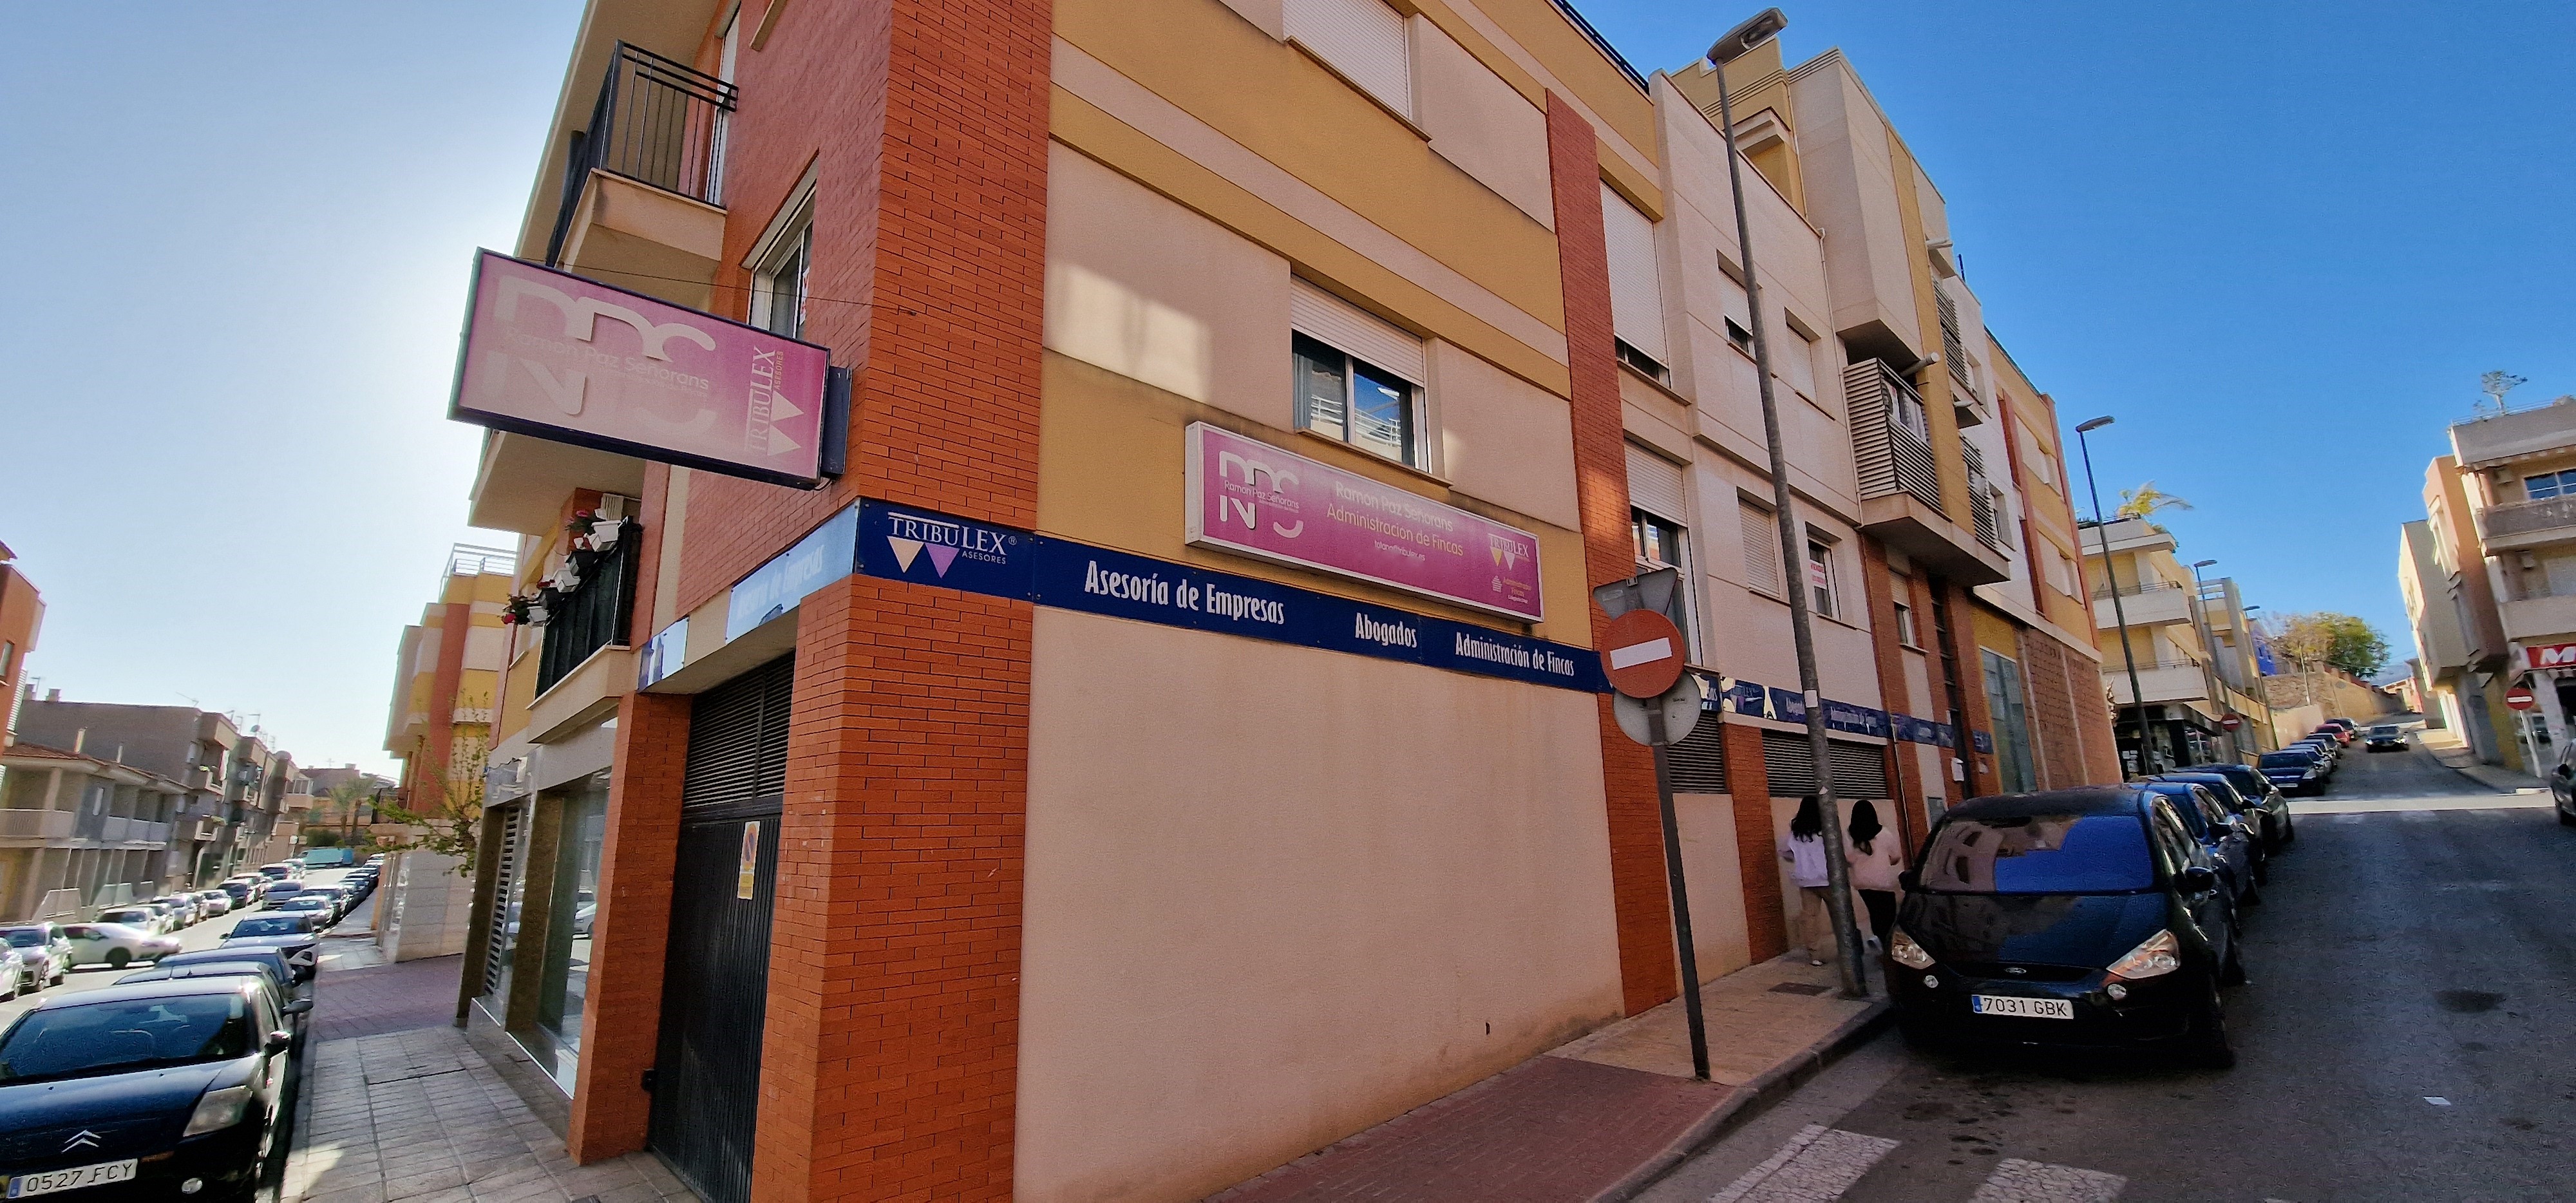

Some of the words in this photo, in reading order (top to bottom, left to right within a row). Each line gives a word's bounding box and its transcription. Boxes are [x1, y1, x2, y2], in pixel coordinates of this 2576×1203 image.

[1224, 480, 1251, 496] Ramon
[1253, 489, 1266, 500] Paz
[1336, 481, 1379, 508] Ramon
[1381, 497, 1403, 516] Paz
[961, 551, 1007, 564] ASESORES
[1416, 531, 1430, 547] de
[1432, 534, 1464, 556] Fincas
[1084, 560, 1169, 605] Asesoría
[1176, 578, 1199, 611] de
[1206, 583, 1285, 625] Empresas
[1355, 612, 1417, 649] Abogados
[1455, 631, 1530, 668] Administración
[1533, 649, 1545, 671] de
[1547, 650, 1575, 676] Fincas
[1983, 998, 2026, 1014] 7031
[2034, 1000, 2067, 1016] GBK
[26, 1170, 84, 1192] 0527
[87, 1163, 133, 1184] FCY
